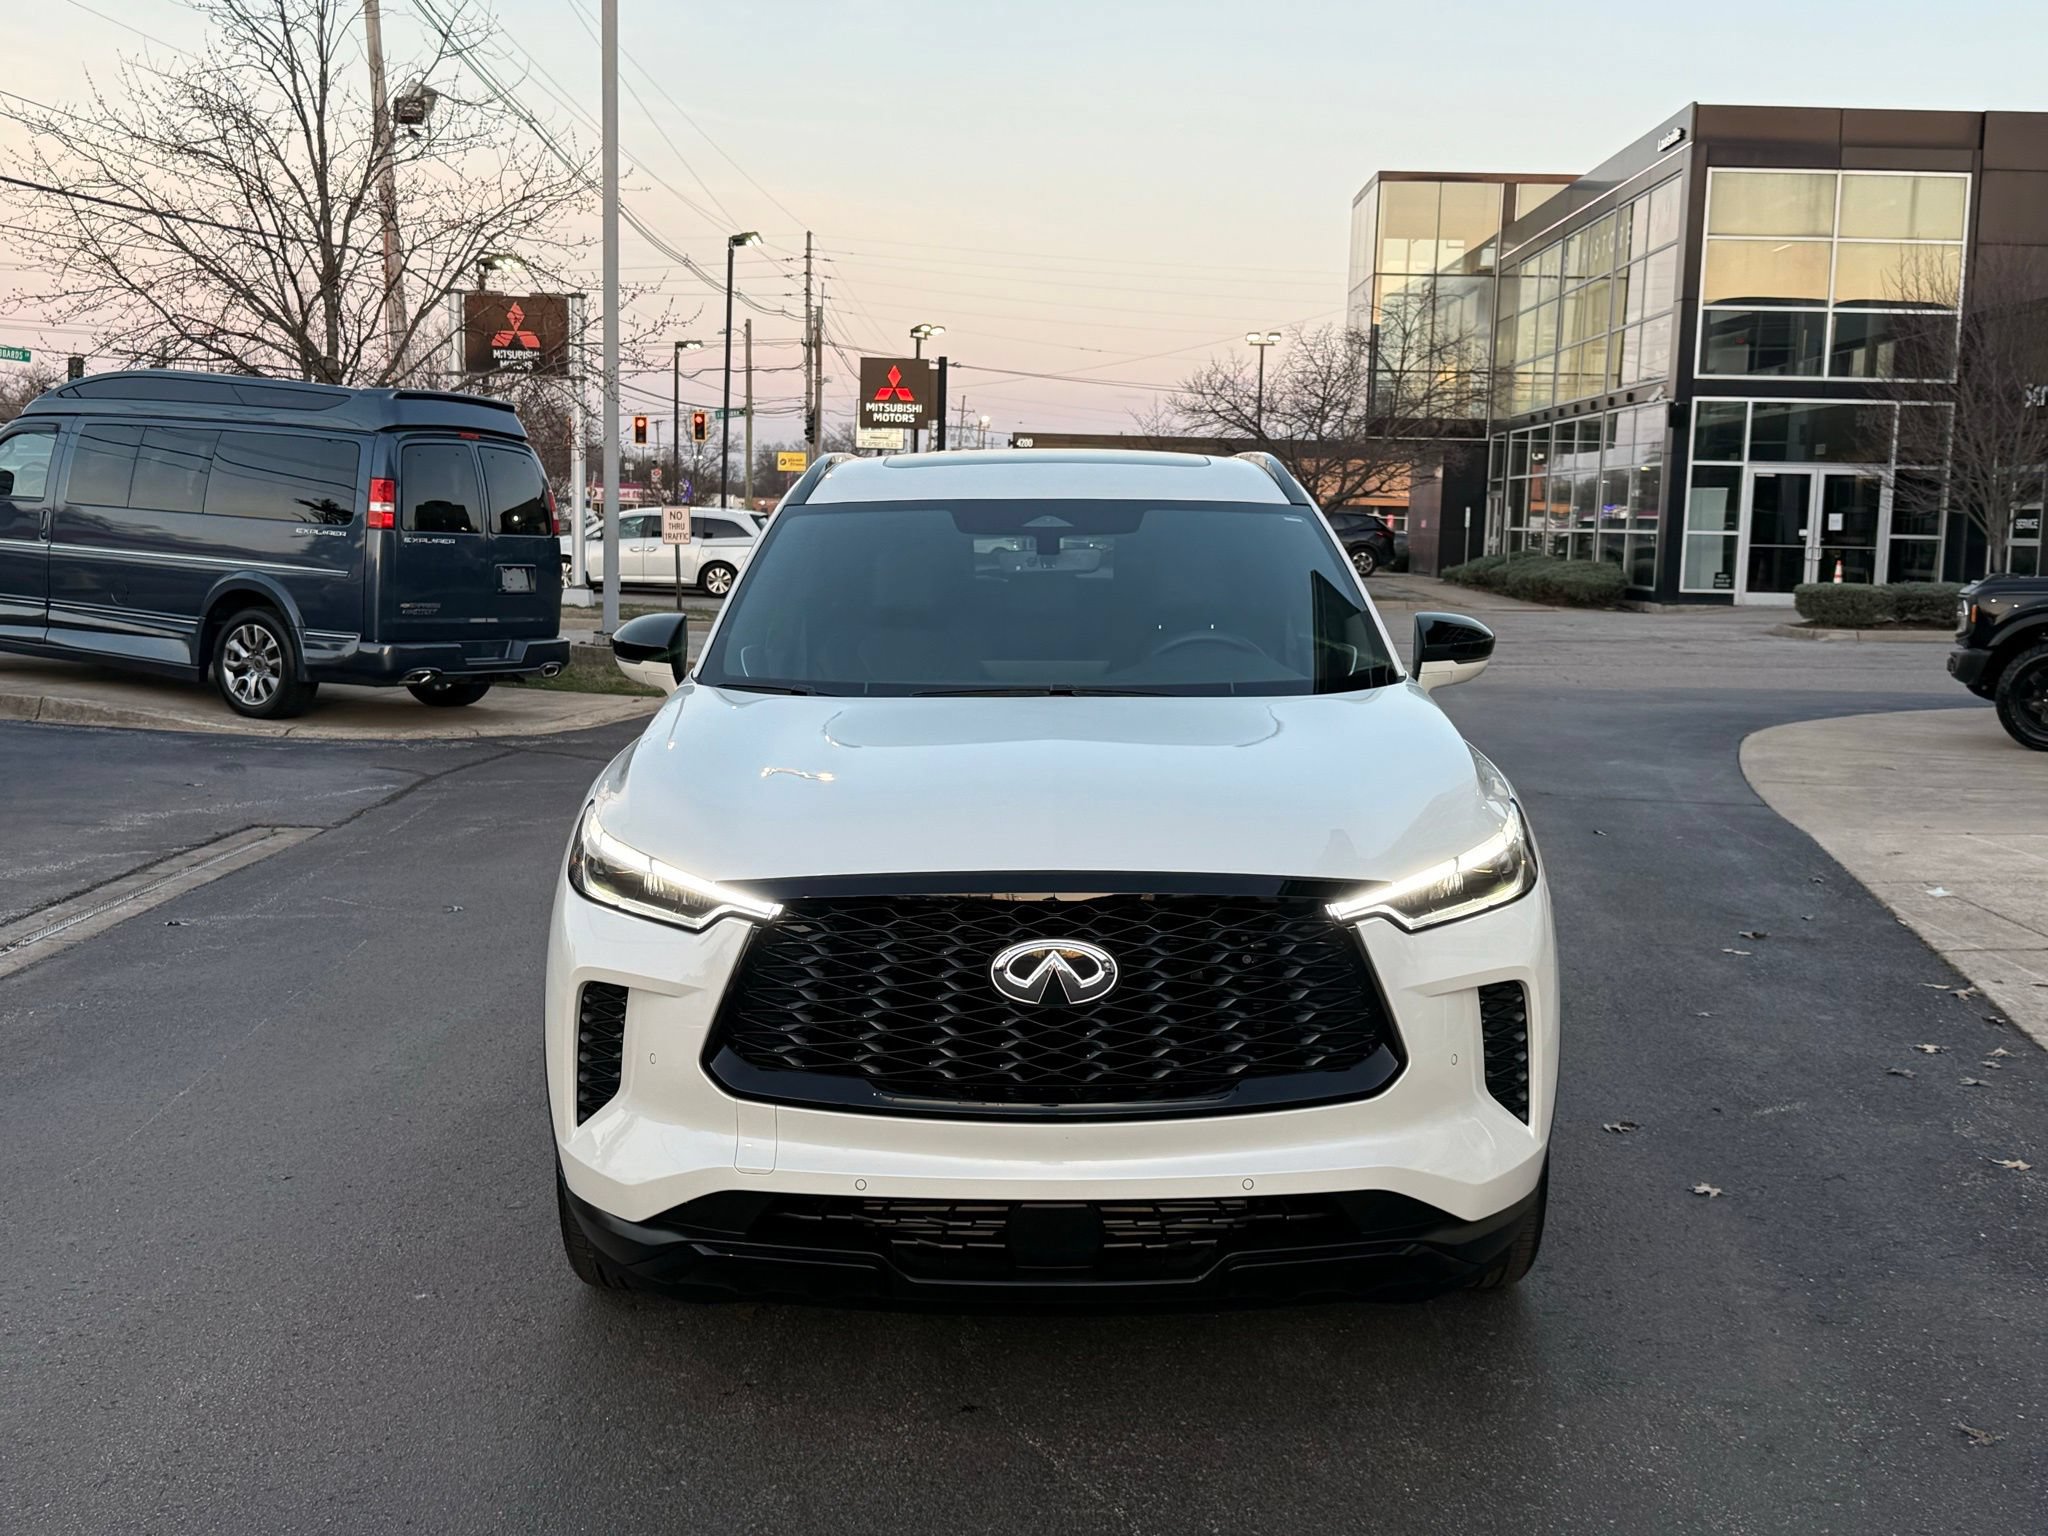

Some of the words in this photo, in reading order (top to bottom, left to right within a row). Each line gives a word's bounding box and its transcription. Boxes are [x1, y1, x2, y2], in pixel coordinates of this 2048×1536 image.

[865, 402, 923, 413] MITSUBISHI
[872, 412, 915, 423] MOTORS
[669, 511, 683, 521] NO
[668, 522, 686, 531] THRU
[665, 532, 689, 541] TRAFFIC
